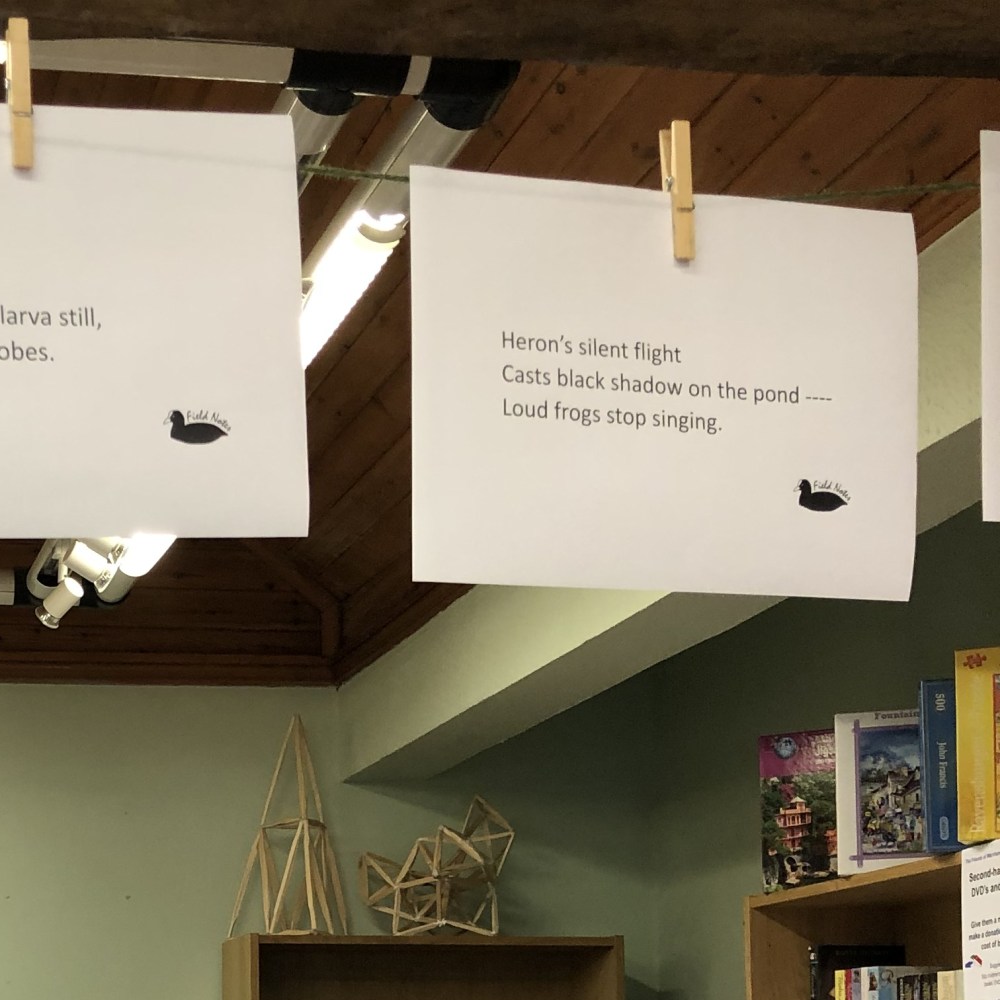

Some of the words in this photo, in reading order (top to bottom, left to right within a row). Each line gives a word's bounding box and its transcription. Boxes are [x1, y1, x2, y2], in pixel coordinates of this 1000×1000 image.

[1, 305, 51, 326] larva
[60, 307, 101, 330] still,
[502, 331, 572, 354] Heron's
[579, 338, 628, 359] silent
[634, 342, 681, 366] flight
[502, 365, 550, 385] Casts
[558, 368, 605, 389] black
[611, 373, 682, 395] shadow
[689, 384, 711, 397] on
[718, 381, 747, 400] the
[754, 386, 799, 405] pond
[186, 409, 209, 423] Field
[210, 411, 231, 432] Notes
[503, 398, 547, 418] Loud
[554, 401, 600, 426] frogs
[607, 408, 646, 430] stop
[653, 410, 722, 435] singing.
[813, 480, 832, 491] Field
[937, 742, 946, 759] John
[939, 762, 947, 789] Francis
